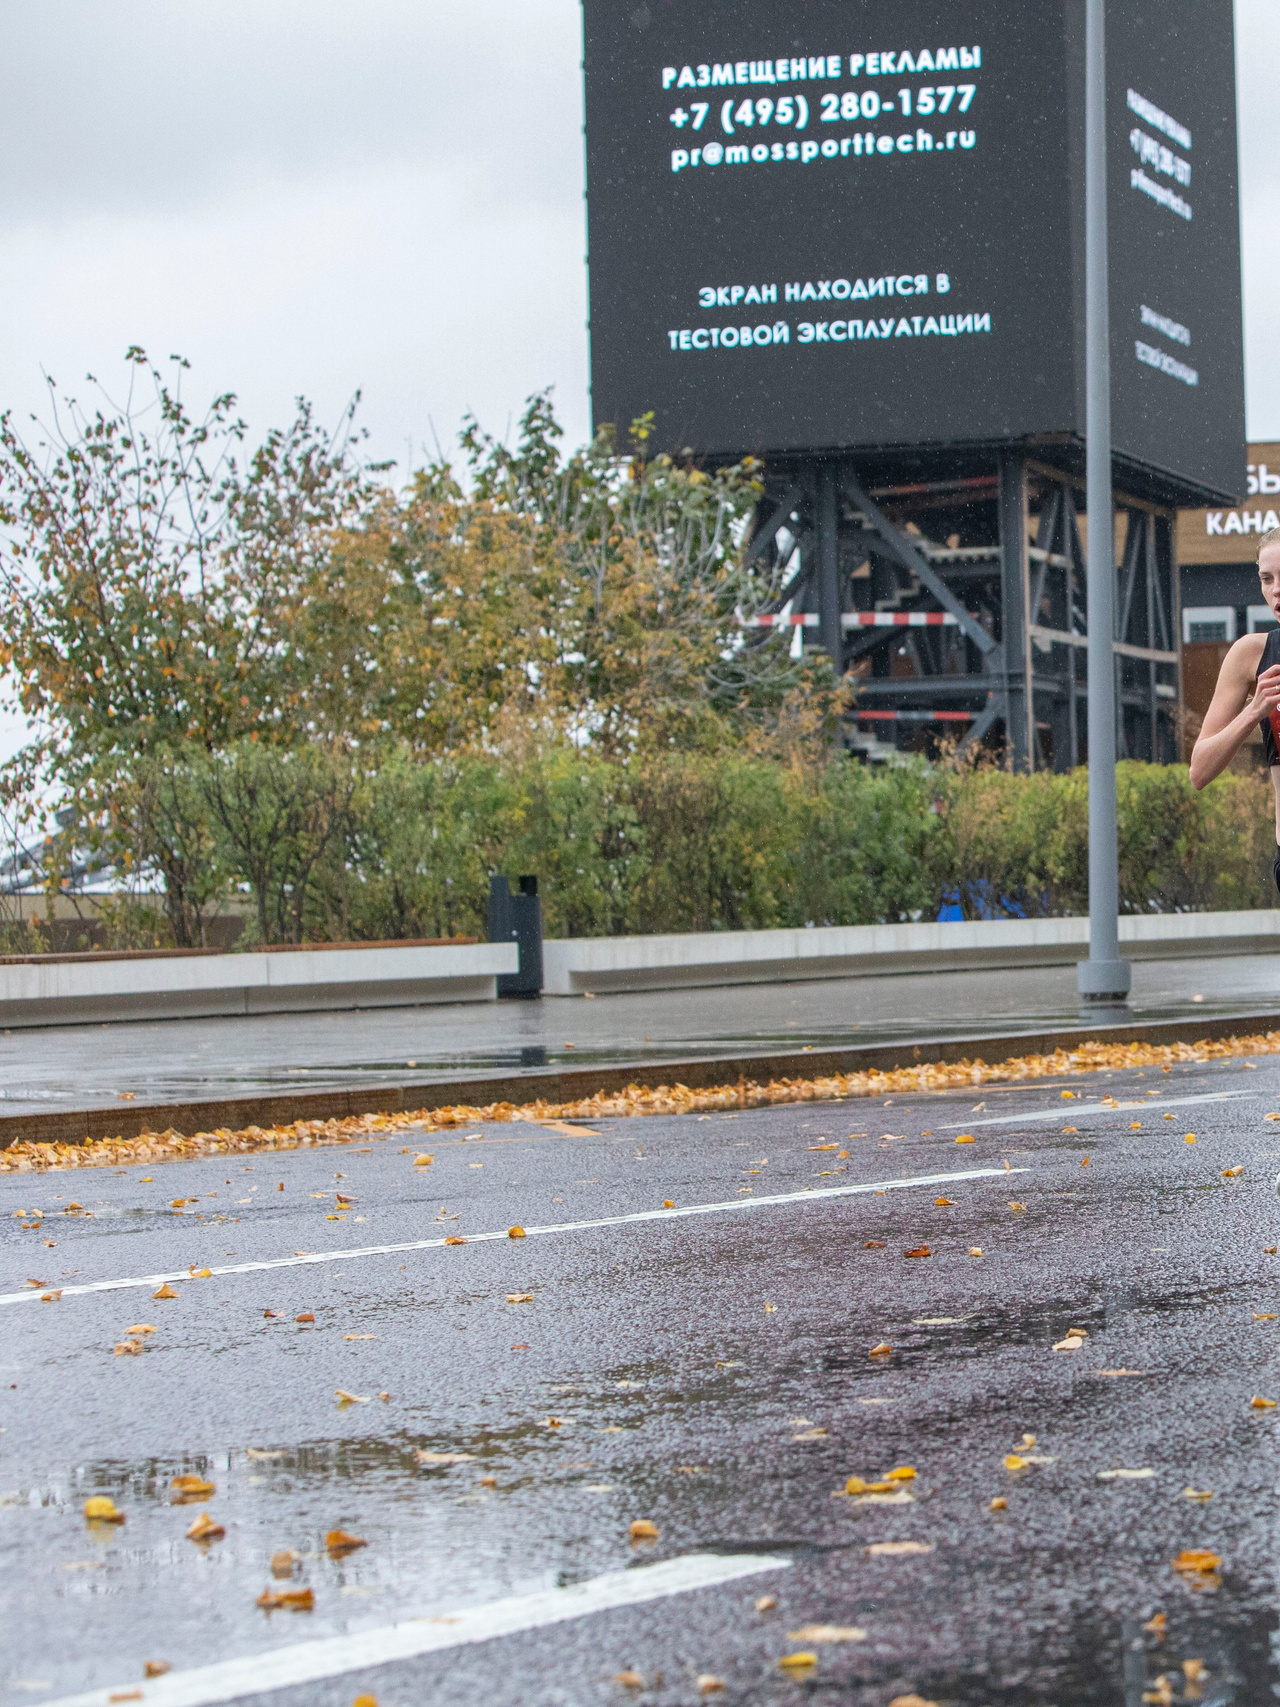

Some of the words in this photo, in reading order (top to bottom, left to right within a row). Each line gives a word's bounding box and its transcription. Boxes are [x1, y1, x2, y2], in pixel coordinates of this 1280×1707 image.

[661, 53, 841, 89] РАЗМЕЩЕНИЕ
[849, 46, 981, 76] РЕКЛАМЫ
[669, 103, 709, 130] +7
[720, 93, 809, 134] (495)
[819, 83, 976, 122] 280-1577
[671, 129, 975, 172] pr@mossporttech.ru
[698, 284, 778, 308] ЭКРАН
[784, 275, 929, 303] НАХОДИТСЯ
[936, 272, 950, 293] В
[667, 320, 790, 350] ТЕСТОВОЙ
[796, 312, 990, 342] ЭКСПЛУАТАЦИИ
